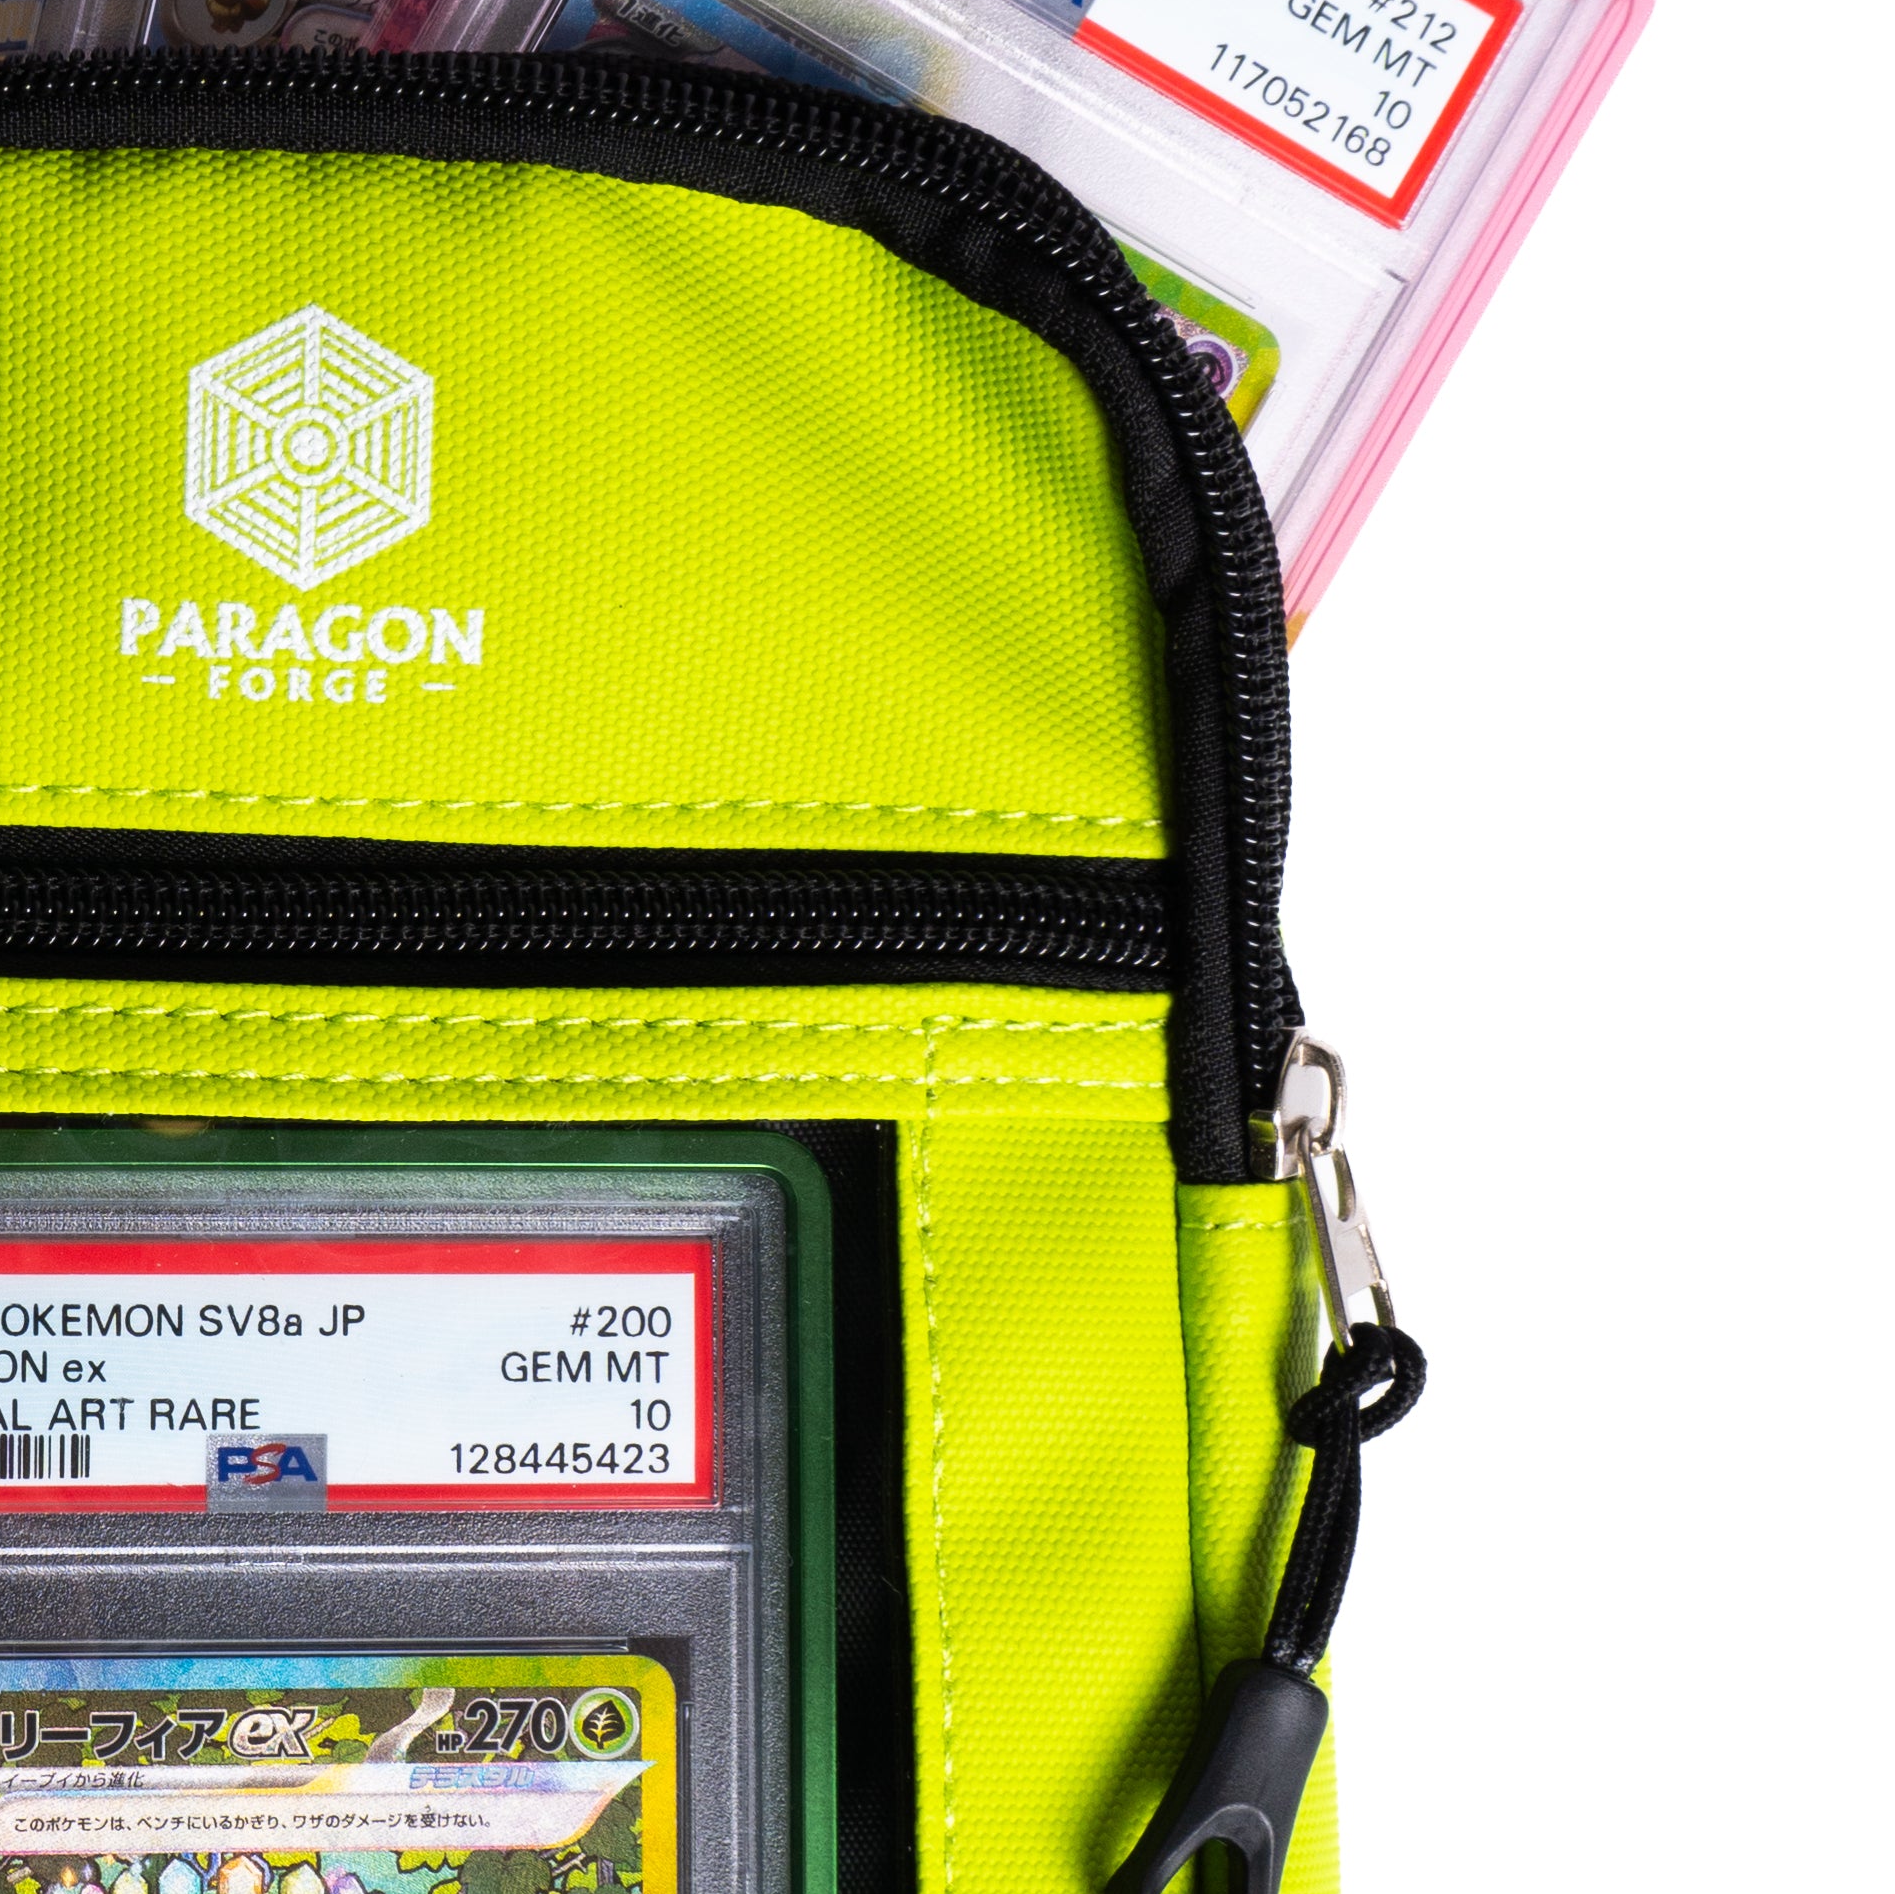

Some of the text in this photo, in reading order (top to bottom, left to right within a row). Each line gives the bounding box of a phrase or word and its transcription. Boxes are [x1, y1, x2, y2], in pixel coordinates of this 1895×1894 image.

[1375, 37, 1438, 87] MT
[1211, 43, 1391, 167] 117052168
[1374, 90, 1411, 130] 10
[120, 596, 485, 666] PARAGON
[208, 665, 388, 704] FORGE
[199, 1304, 302, 1337] SV8a
[319, 1304, 365, 1337] JP
[571, 1305, 672, 1338] #200
[62, 1359, 106, 1383] ex
[501, 1350, 669, 1383] GEM MT
[48, 1397, 135, 1431] ART
[150, 1398, 260, 1431] RARE
[630, 1399, 671, 1431] 10
[217, 1443, 319, 1484] PSA
[451, 1442, 669, 1474] 128445423
[2, 1770, 145, 1790] イーブイから進化
[409, 1765, 536, 1790] テラスタル
